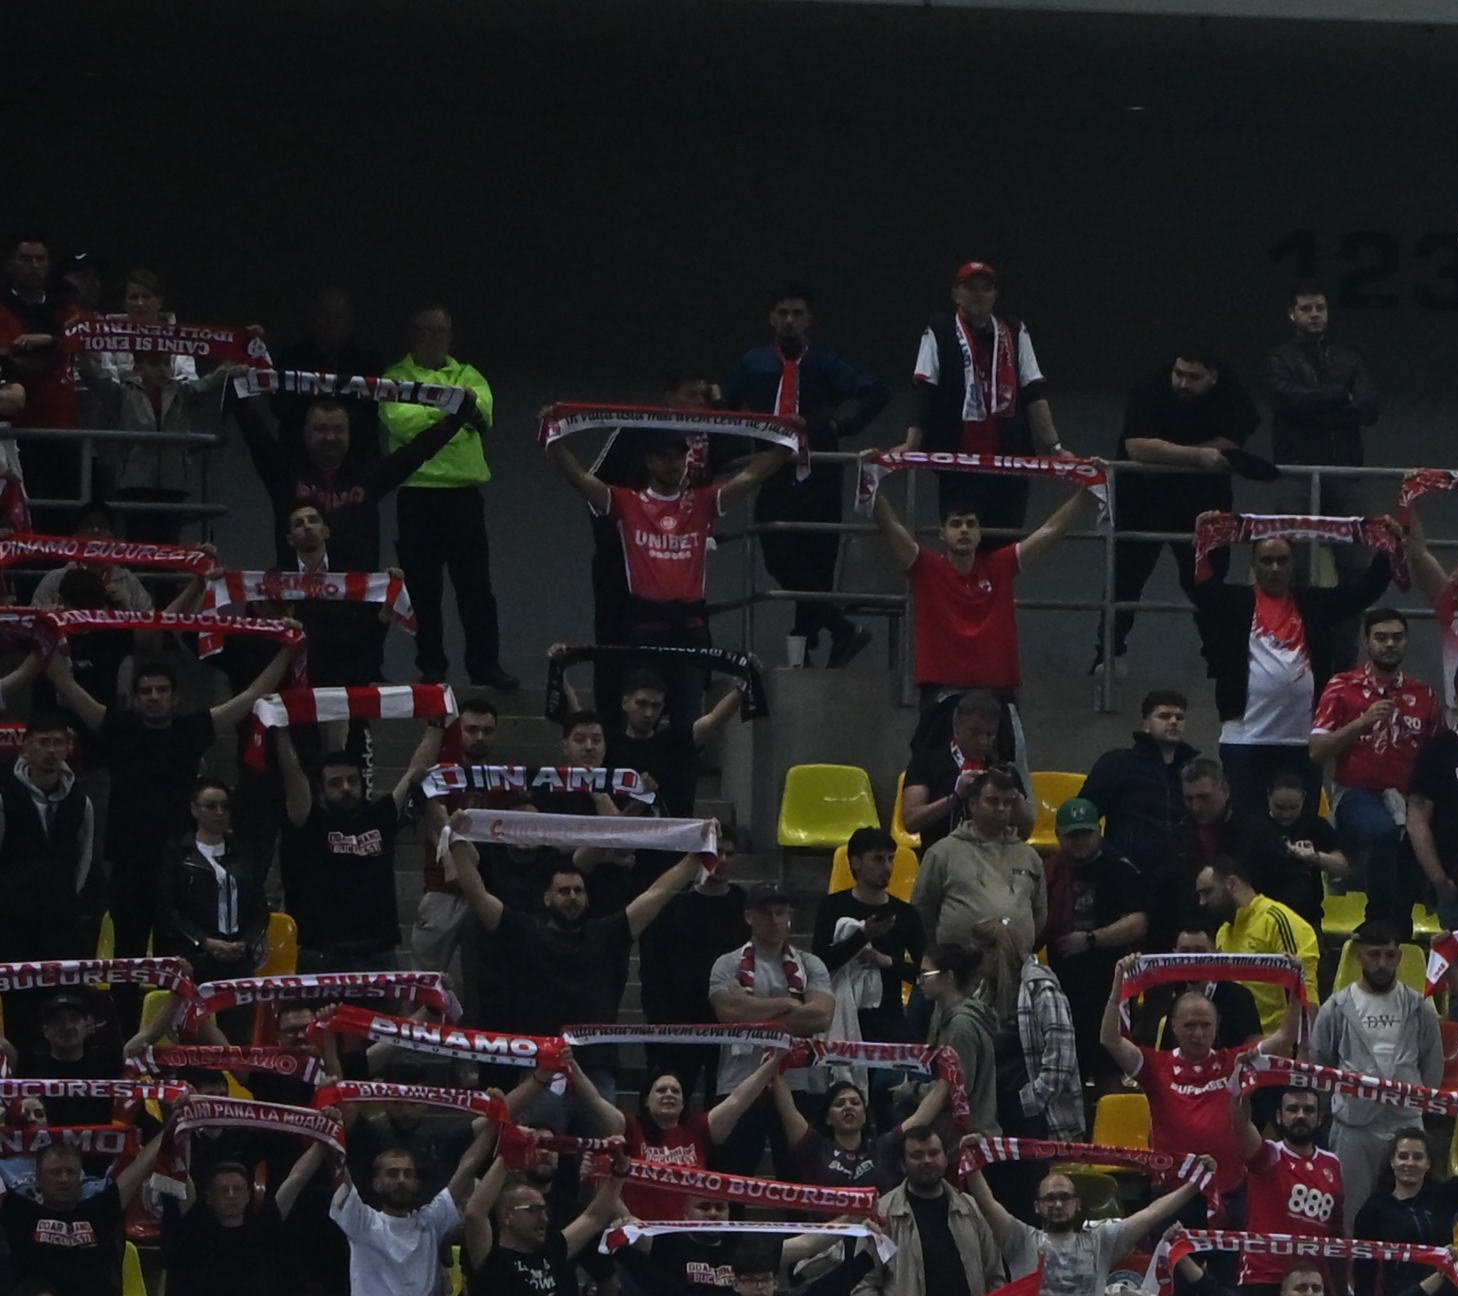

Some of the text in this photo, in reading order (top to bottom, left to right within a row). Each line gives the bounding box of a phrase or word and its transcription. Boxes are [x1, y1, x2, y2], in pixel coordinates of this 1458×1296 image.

[635, 531, 701, 549] UNIBET
[448, 764, 643, 791] DINAMO
[235, 983, 417, 1005] BUCURESTI
[372, 1017, 538, 1058] DINAMO
[1169, 1076, 1230, 1095] SUPERBET
[726, 1175, 876, 1208] BUCURESTI
[1287, 1182, 1335, 1216] 888
[1193, 1238, 1413, 1263] BUCURESTI
